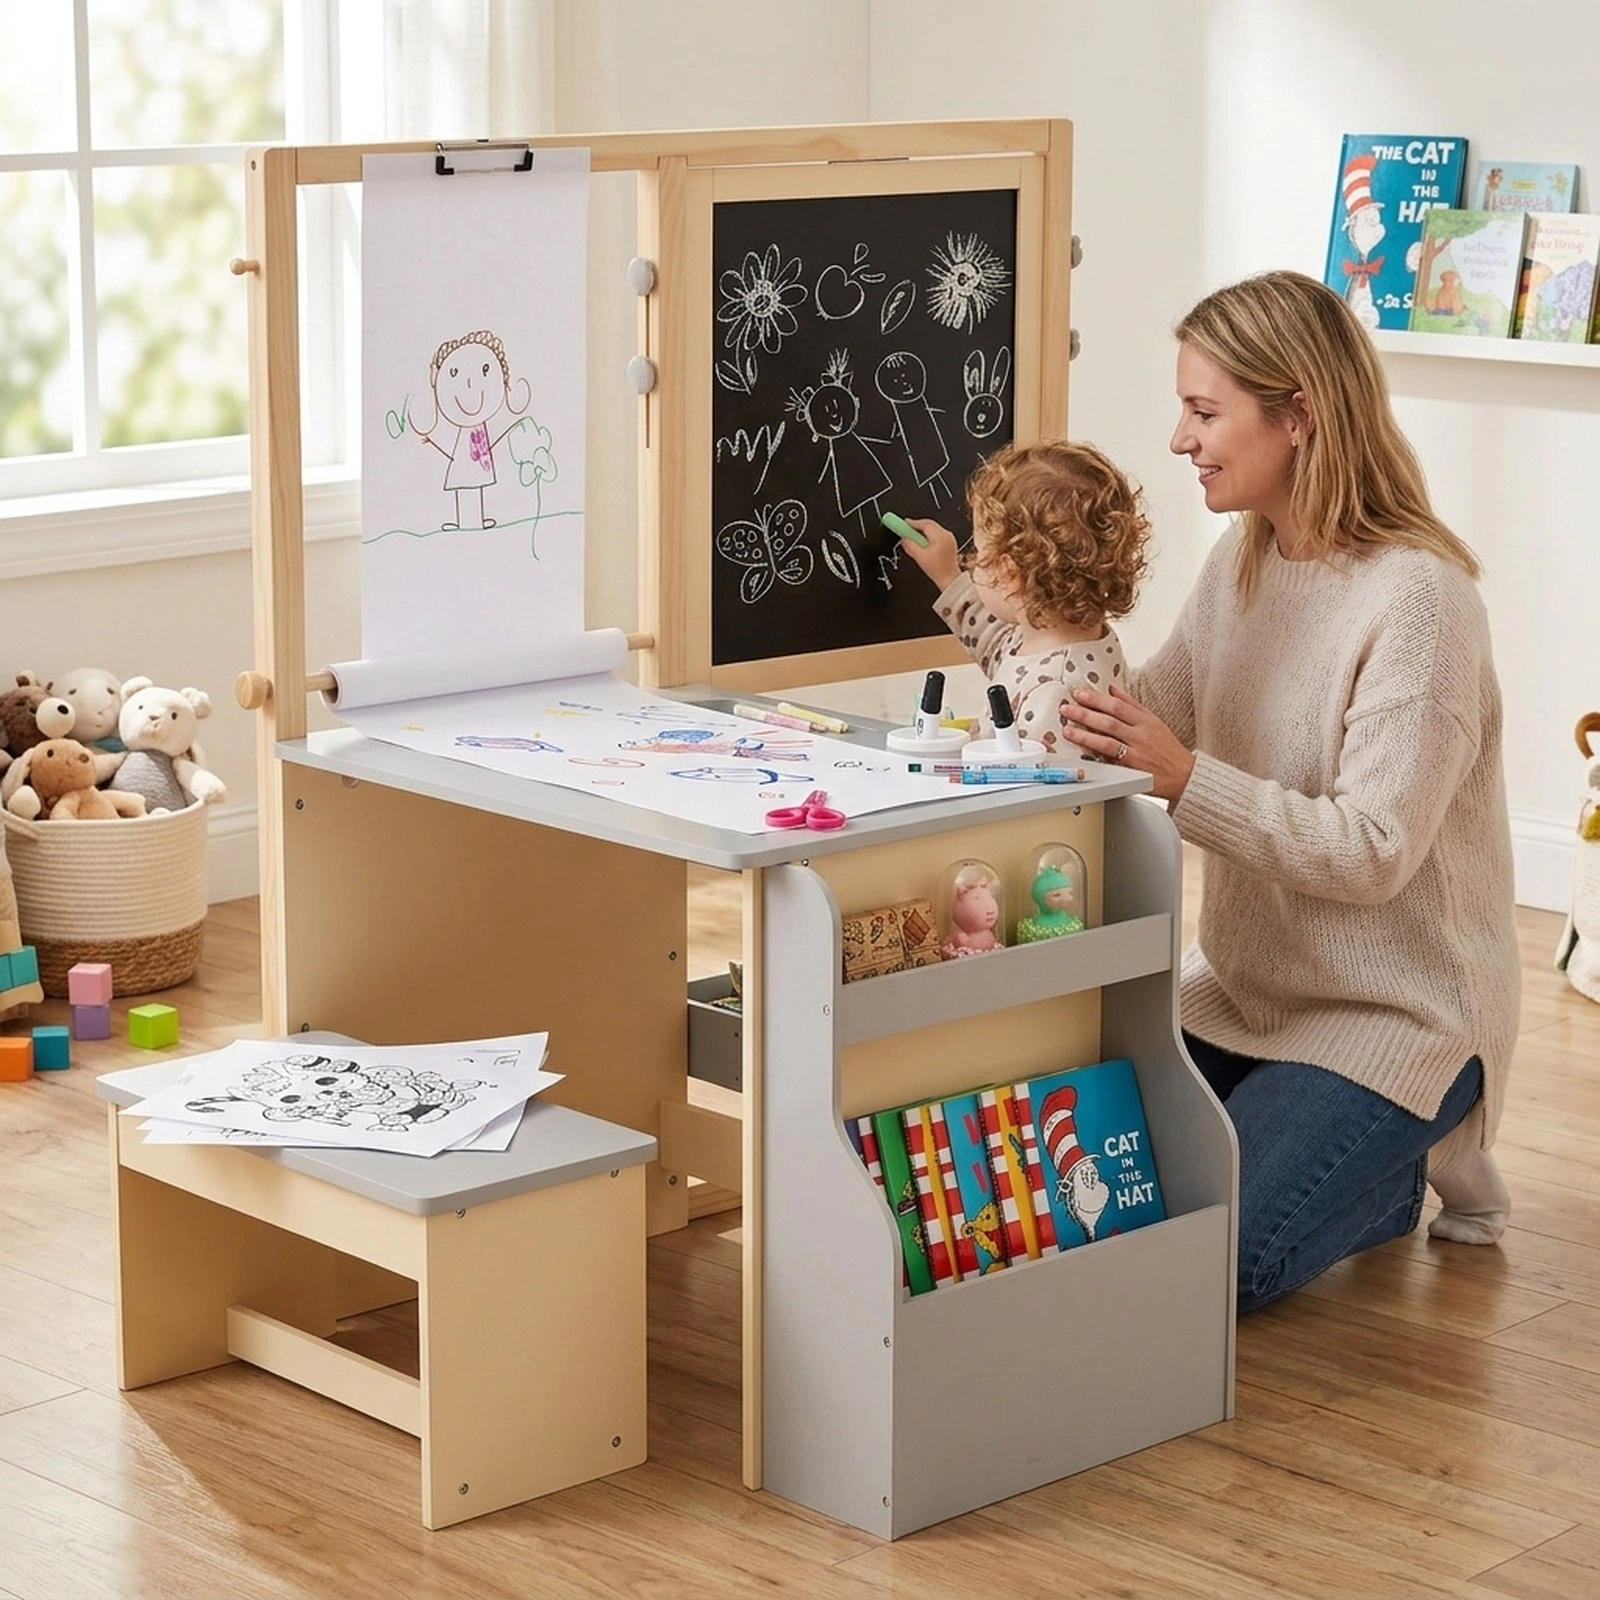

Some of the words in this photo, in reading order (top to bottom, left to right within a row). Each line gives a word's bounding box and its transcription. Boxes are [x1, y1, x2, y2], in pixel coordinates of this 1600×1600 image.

[1371, 145, 1403, 160] THE
[1404, 141, 1456, 165] CAT
[1421, 169, 1437, 181] IN
[1412, 185, 1440, 198] THE
[1104, 1130, 1140, 1157] CAT
[1121, 1156, 1134, 1168] IN
[1116, 1181, 1154, 1210] HAT
